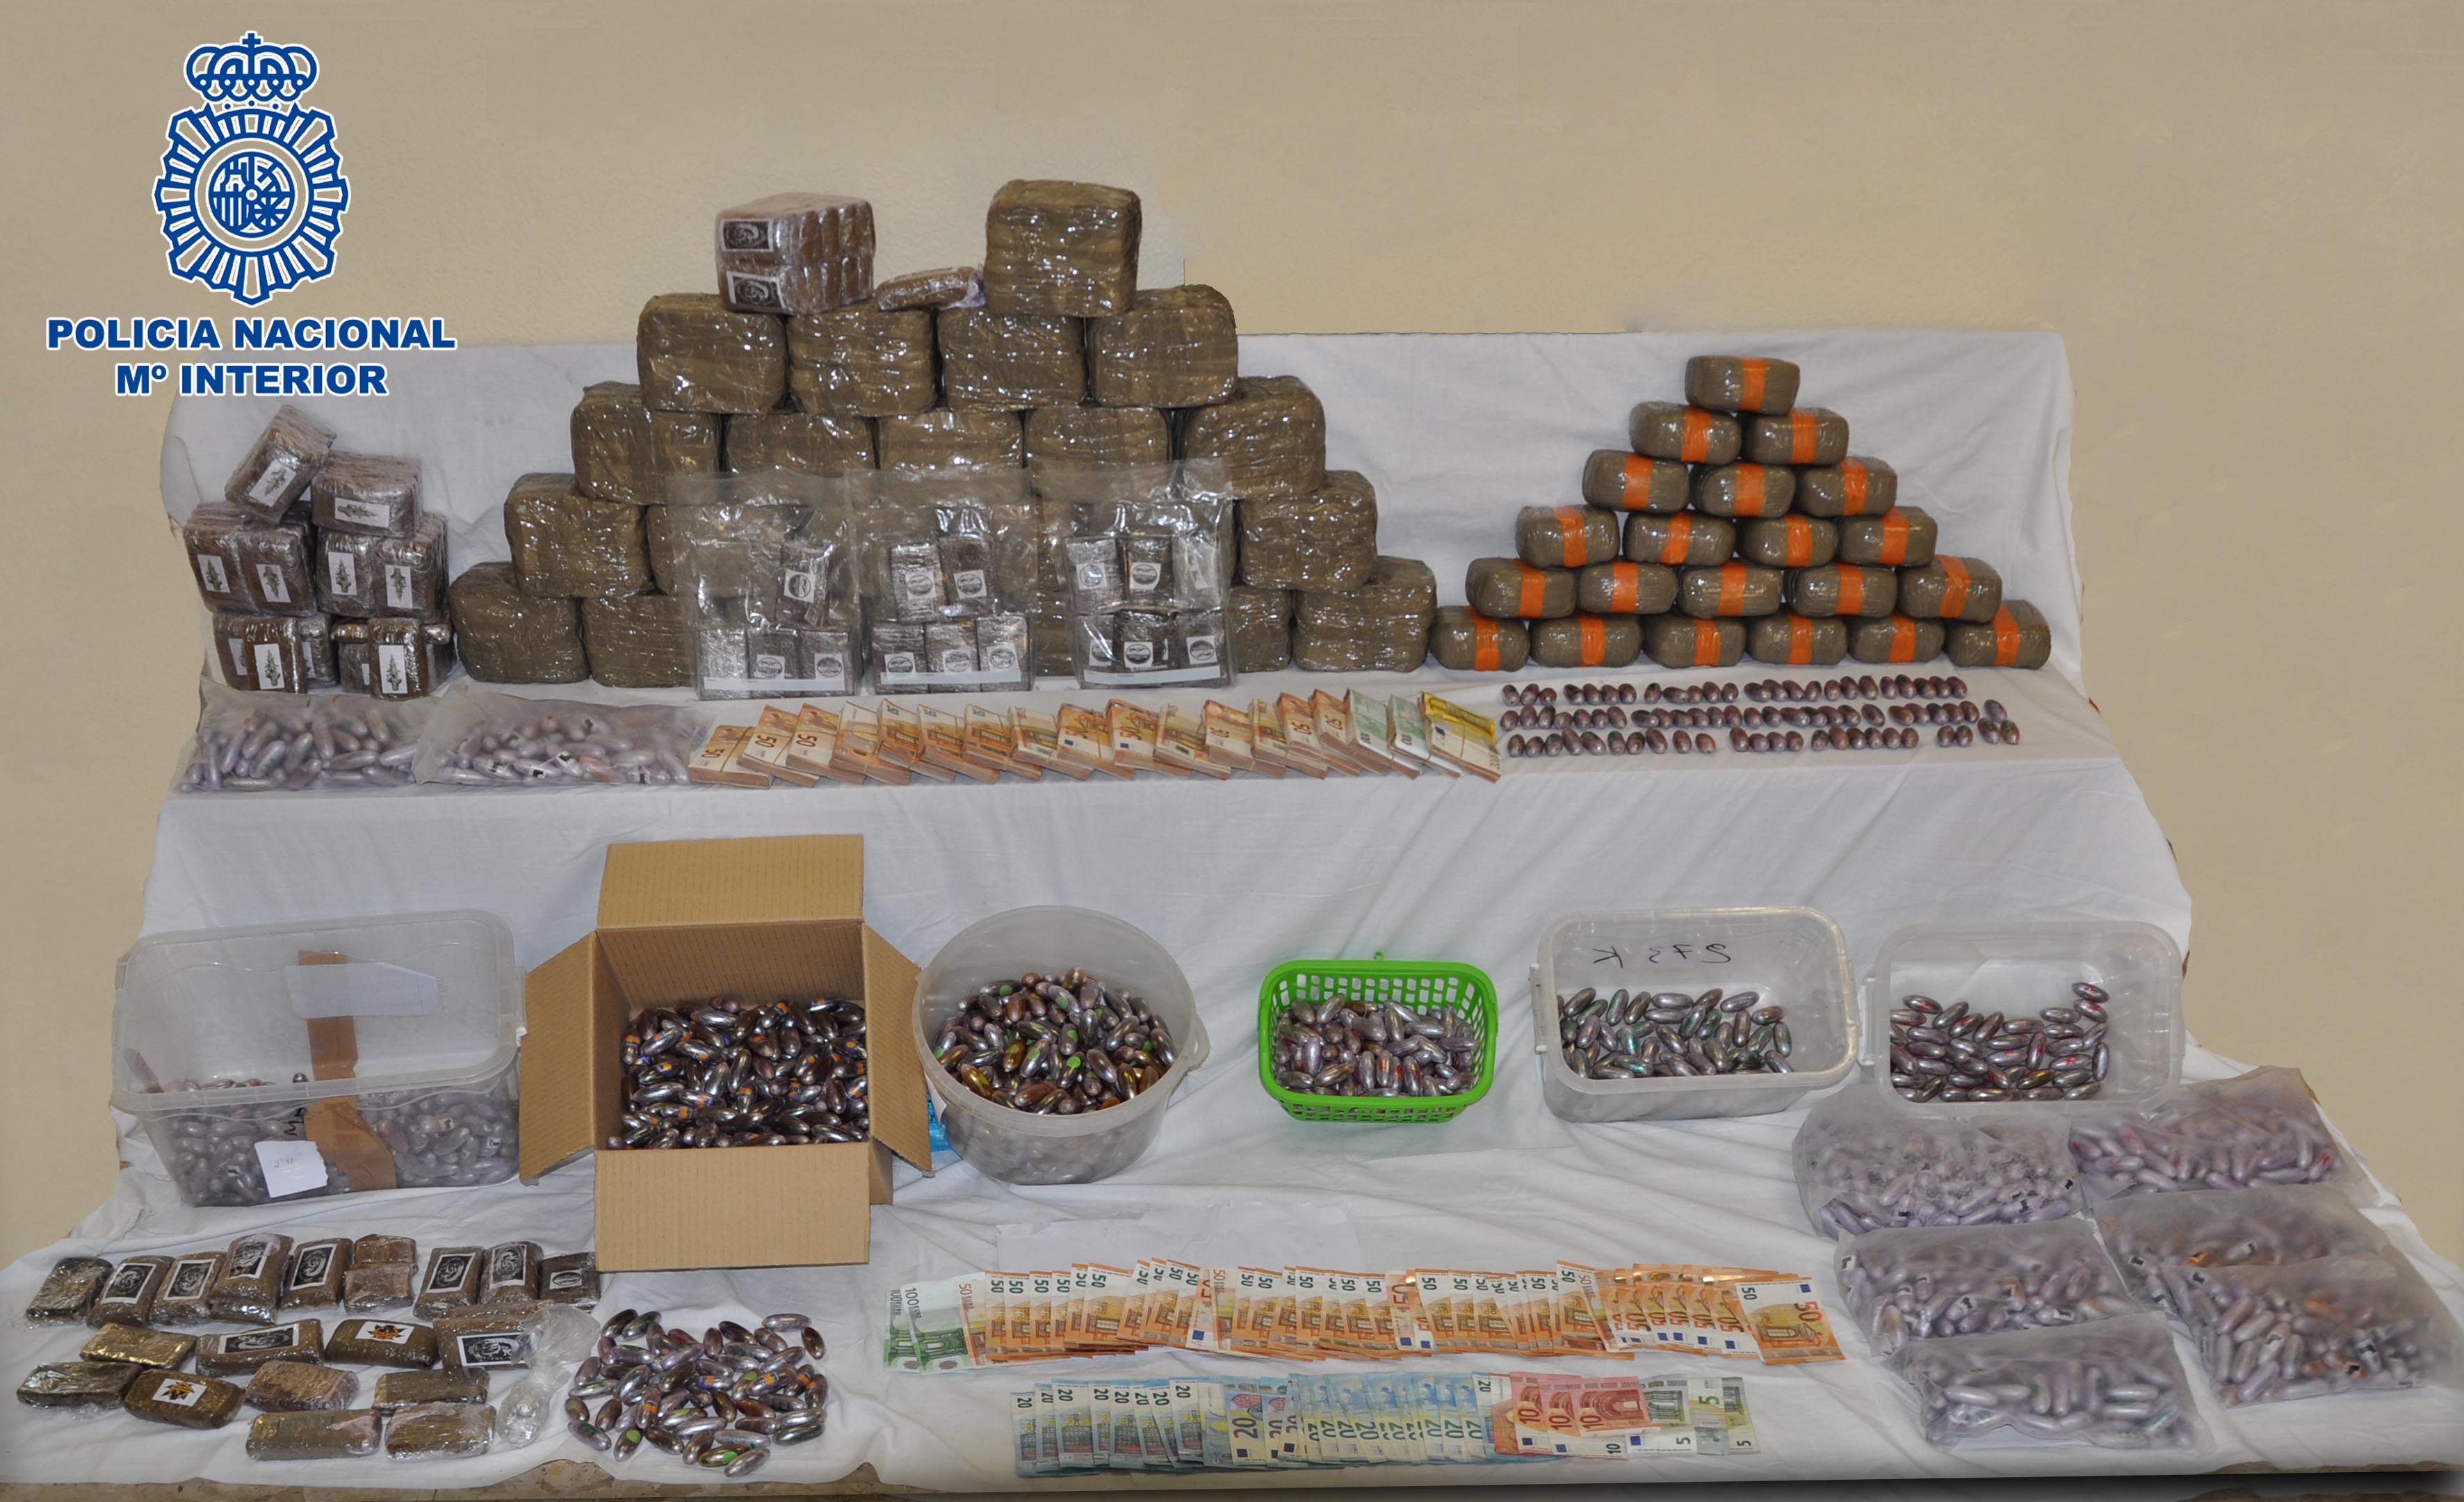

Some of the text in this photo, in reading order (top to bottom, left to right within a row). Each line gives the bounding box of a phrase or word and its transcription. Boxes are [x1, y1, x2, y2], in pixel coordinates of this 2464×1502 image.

[754, 734, 777, 748] 50
[796, 734, 818, 748] 50
[1091, 1273, 1106, 1287] 50
[1169, 1267, 1183, 1280] 50
[1186, 1273, 1199, 1285] 50
[1562, 1270, 1575, 1283] 50
[991, 1280, 1004, 1293] 50
[1009, 1280, 1023, 1293] 50
[1035, 1279, 1049, 1293] 50
[1057, 1279, 1070, 1293] 50
[1258, 1277, 1272, 1289] 50
[1299, 1276, 1313, 1288] 50
[1341, 1279, 1356, 1291] 50
[1366, 1280, 1381, 1293] 50
[1422, 1277, 1437, 1290] 50
[1454, 1278, 1468, 1290] 50
[1531, 1277, 1546, 1290] 50
[959, 1283, 972, 1295] 50
[1742, 1287, 1758, 1300] 50
[905, 1287, 919, 1307] 100
[1794, 1301, 1822, 1322] 50
[1717, 1317, 1744, 1332] 50
[1176, 1385, 1191, 1398] 20
[1478, 1380, 1491, 1393] 20
[1058, 1389, 1073, 1401] 20
[1094, 1389, 1109, 1400] 20
[1115, 1391, 1129, 1403] 20
[1135, 1392, 1149, 1405] 20
[1153, 1391, 1170, 1405] 20
[1699, 1395, 1719, 1405] 5
[1017, 1397, 1032, 1408] 20
[1518, 1407, 1541, 1424] 10
[1548, 1414, 1573, 1430] 10
[1580, 1414, 1604, 1429] 10
[1231, 1417, 1258, 1439] 20
[1337, 1420, 1356, 1439] 20
[1355, 1421, 1379, 1440] 20
[1425, 1419, 1443, 1437] 20
[1444, 1419, 1464, 1439] 20
[1676, 1437, 1690, 1445] 5
[1606, 1443, 1621, 1454] 10
